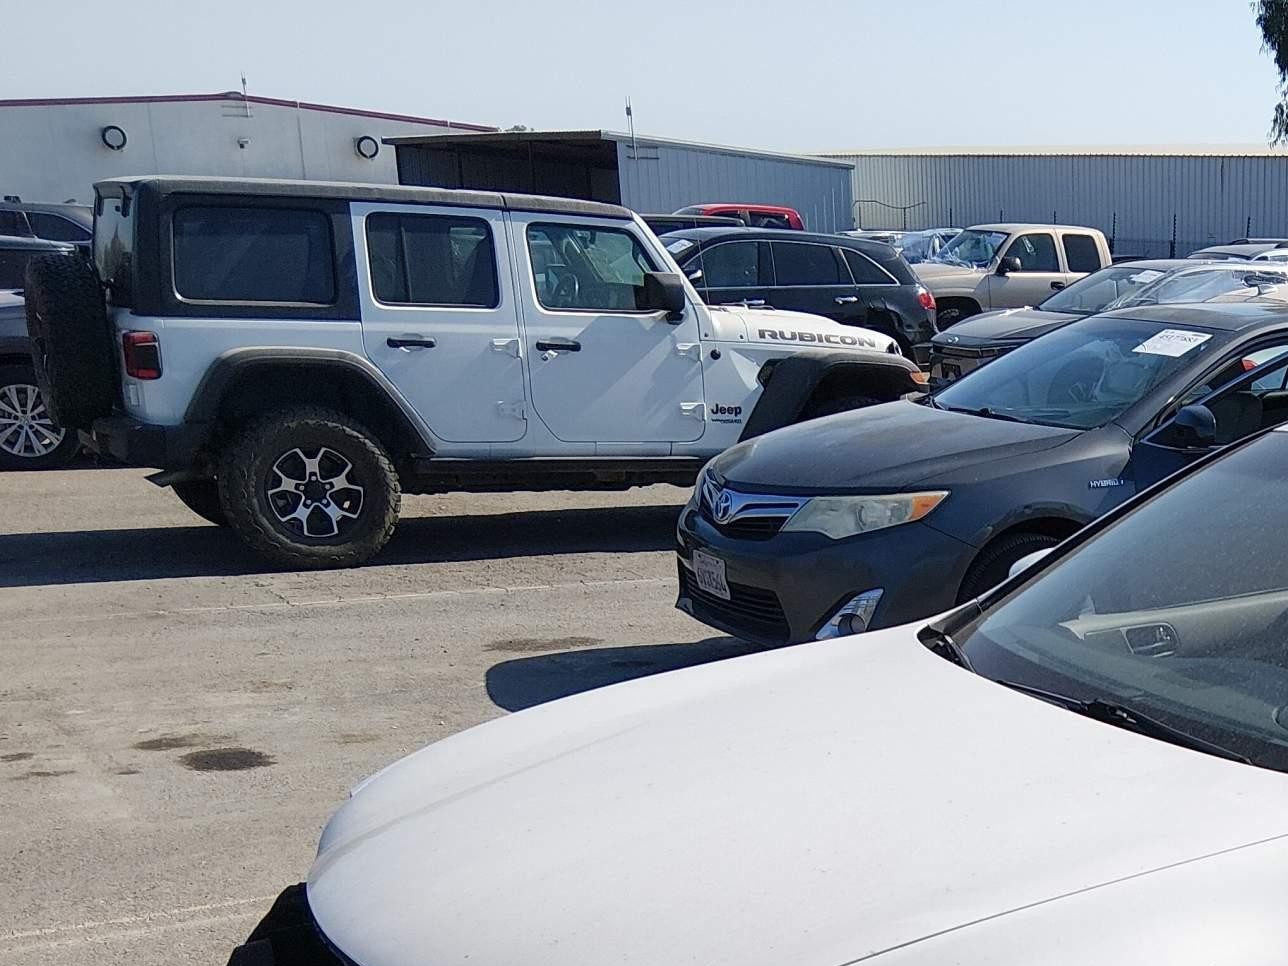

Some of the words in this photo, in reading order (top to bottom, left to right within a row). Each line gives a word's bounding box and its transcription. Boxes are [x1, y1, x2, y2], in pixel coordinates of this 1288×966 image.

[757, 328, 876, 348] RUBICON
[711, 403, 742, 417] Jeep
[1089, 478, 1120, 488] HYBRID
